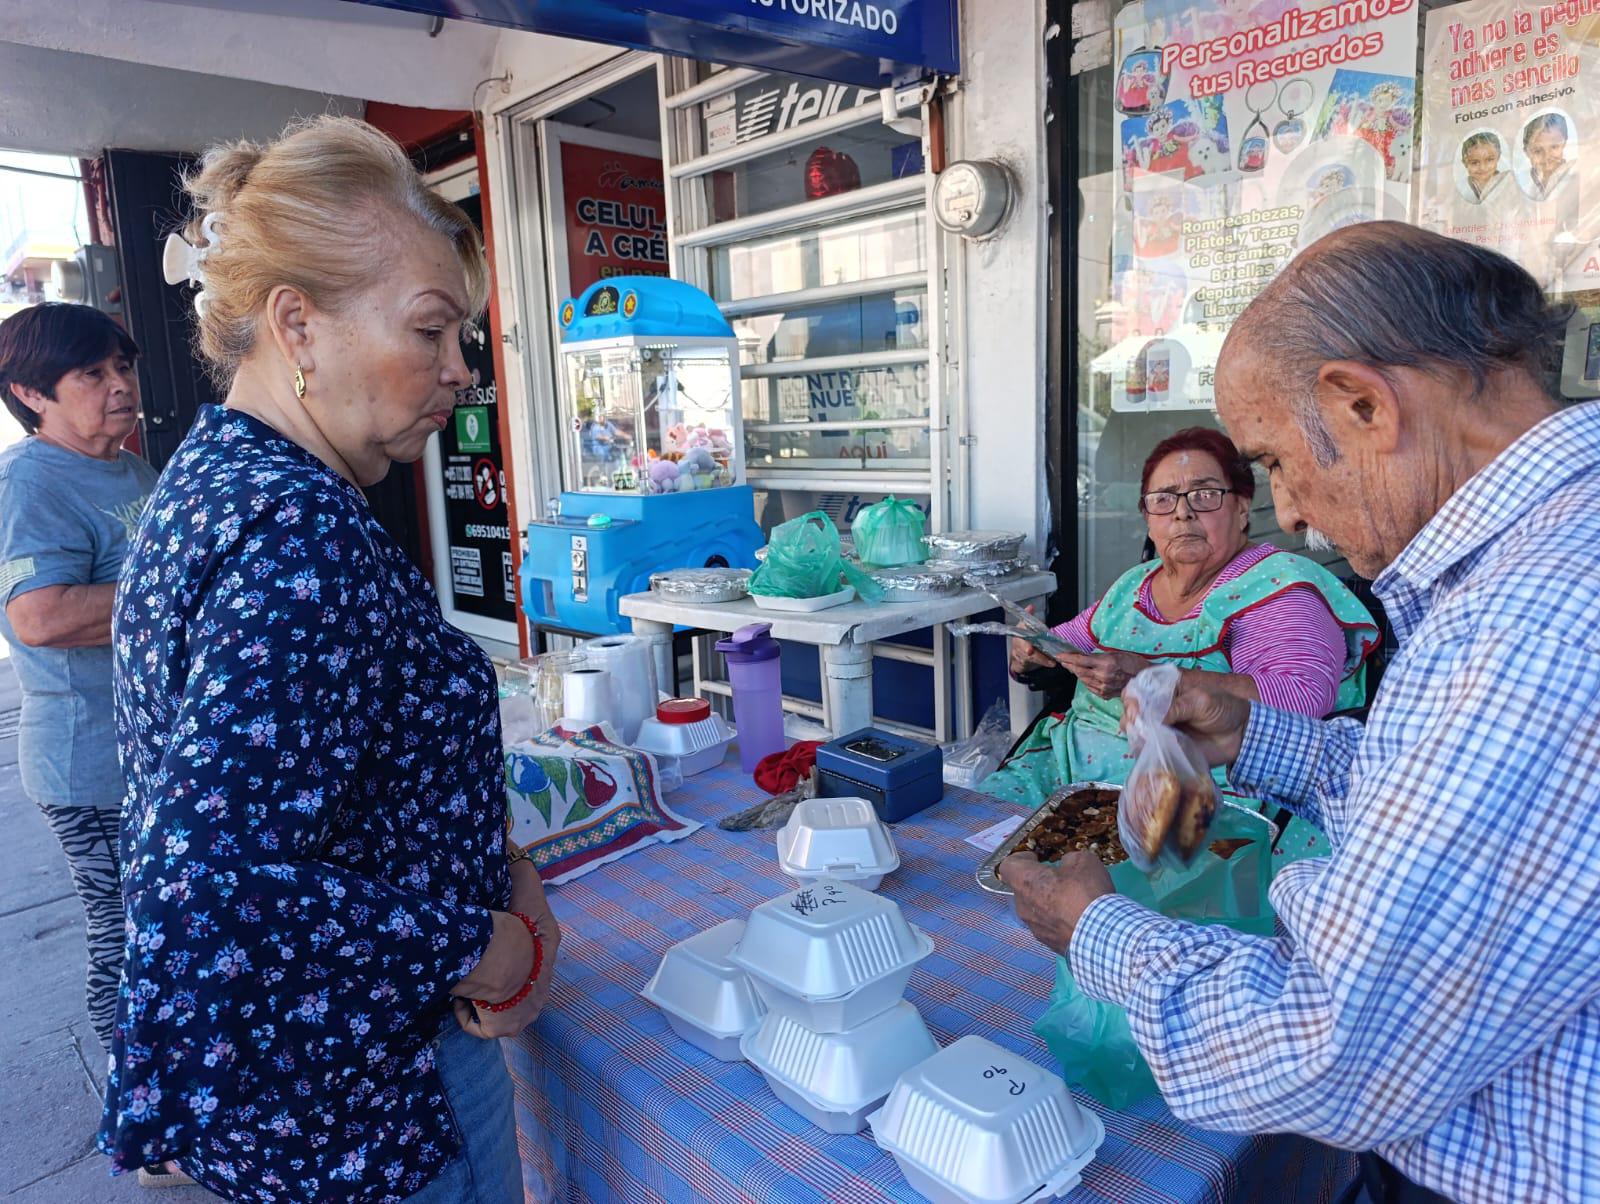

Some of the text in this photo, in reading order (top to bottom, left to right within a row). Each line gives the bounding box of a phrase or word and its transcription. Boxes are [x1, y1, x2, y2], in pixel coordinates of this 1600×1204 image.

[1448, 22, 1475, 53] Ya
[1482, 18, 1507, 44] no
[1190, 32, 1383, 98] tus Recuerdos
[1449, 31, 1561, 81] adhiere es
[1450, 54, 1581, 108] más sencillo
[1454, 85, 1576, 124] Fotos con adhesivo.
[577, 198, 667, 235] CELUL
[1181, 205, 1304, 236] Rompecabezas,
[585, 230, 669, 263] A CRÉ
[1185, 233, 1234, 253] Platos
[1250, 223, 1300, 243] Tazas
[1189, 243, 1292, 268] de Cerámica,
[1210, 262, 1275, 283] Botellas
